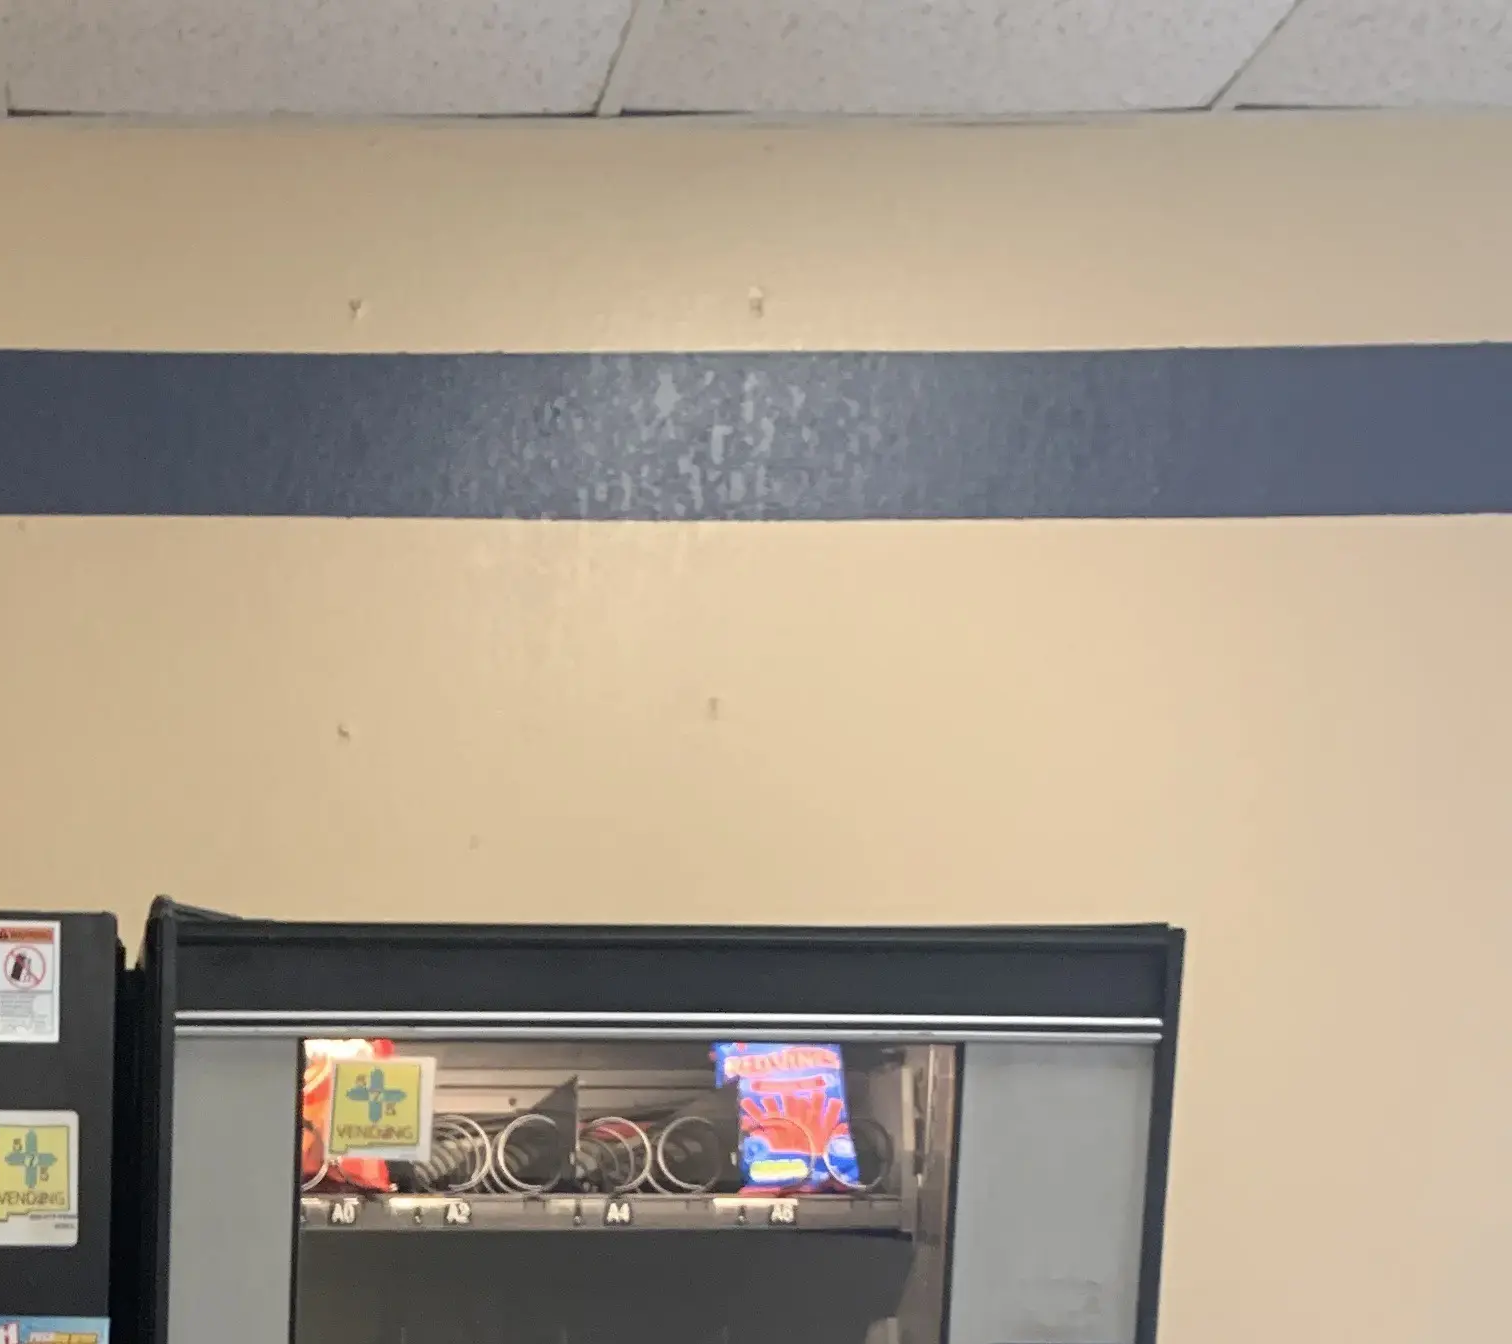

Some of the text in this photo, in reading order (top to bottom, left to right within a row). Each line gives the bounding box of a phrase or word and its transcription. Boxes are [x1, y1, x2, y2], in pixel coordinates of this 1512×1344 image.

[335, 1123, 413, 1140] VENDING
[331, 1203, 356, 1224] A0
[447, 1202, 473, 1223] A2
[607, 1203, 631, 1223] A4
